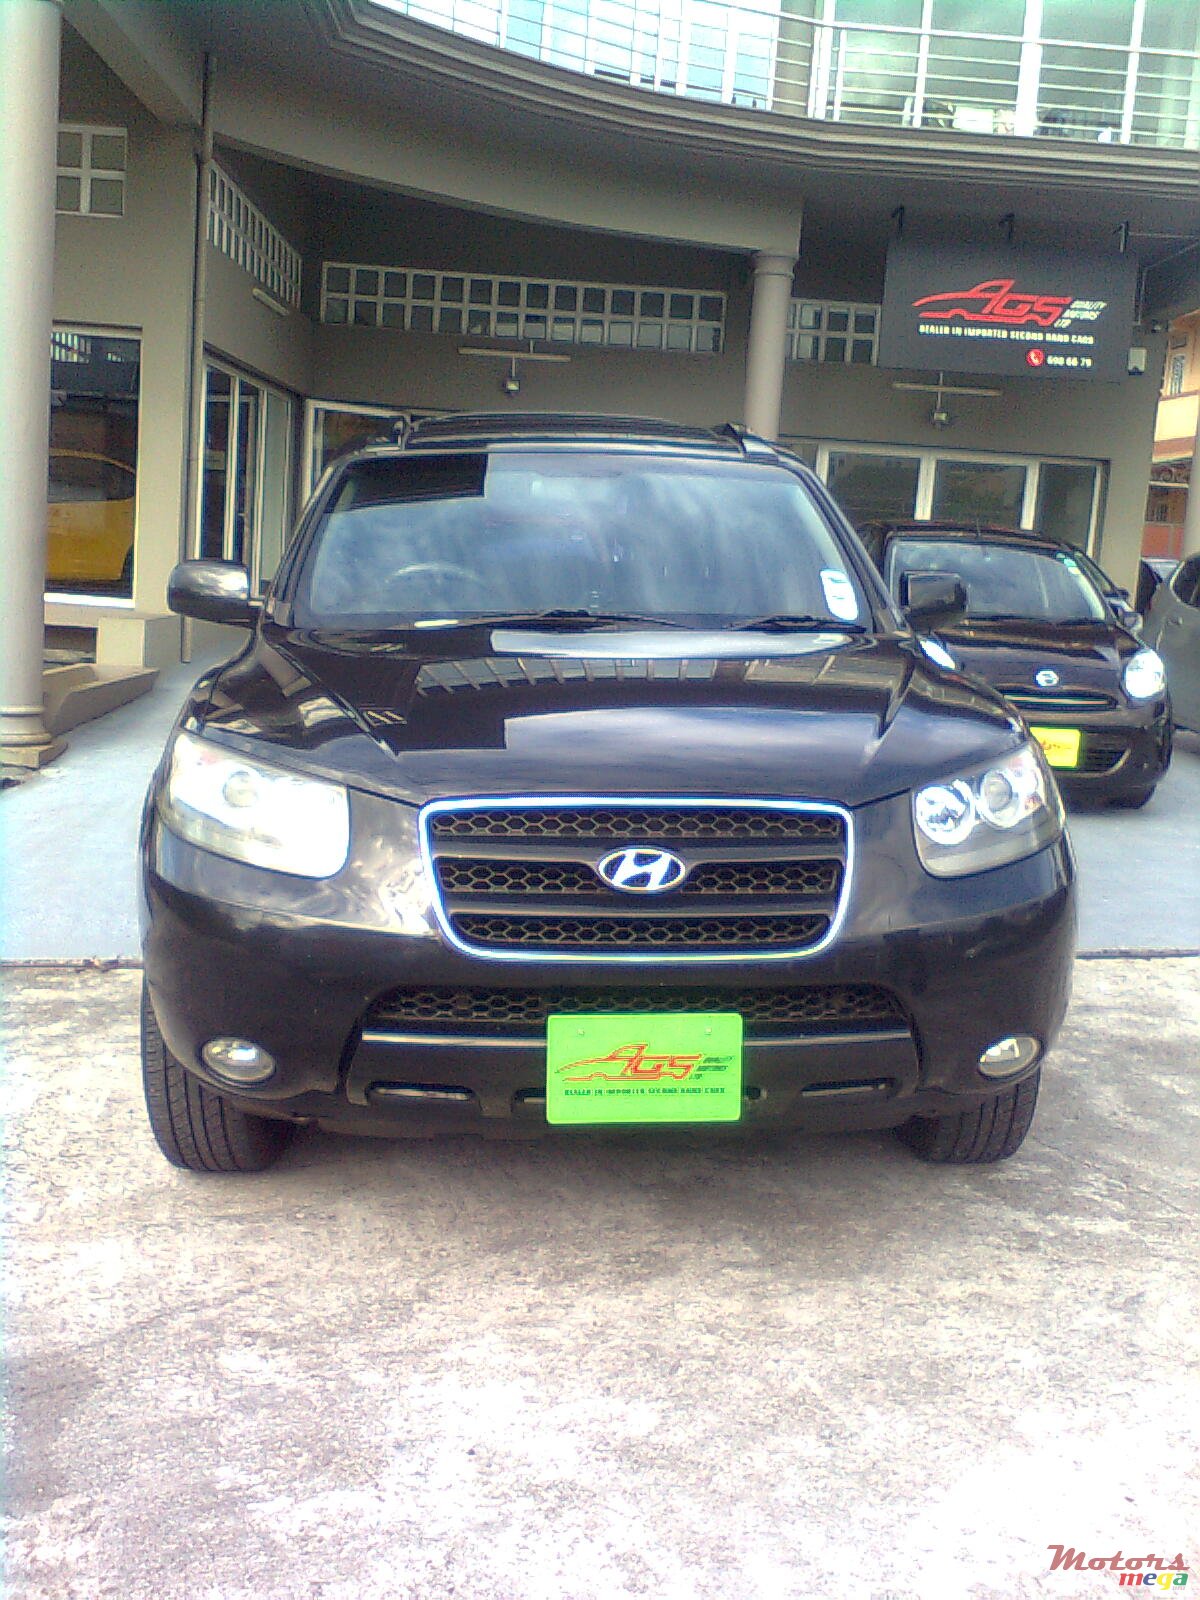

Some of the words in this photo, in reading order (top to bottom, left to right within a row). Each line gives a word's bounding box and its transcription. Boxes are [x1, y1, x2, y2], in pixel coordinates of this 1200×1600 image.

[966, 278, 1072, 326] AGS
[964, 327, 1008, 339] IMPORTED
[1009, 330, 1044, 341] SECOND
